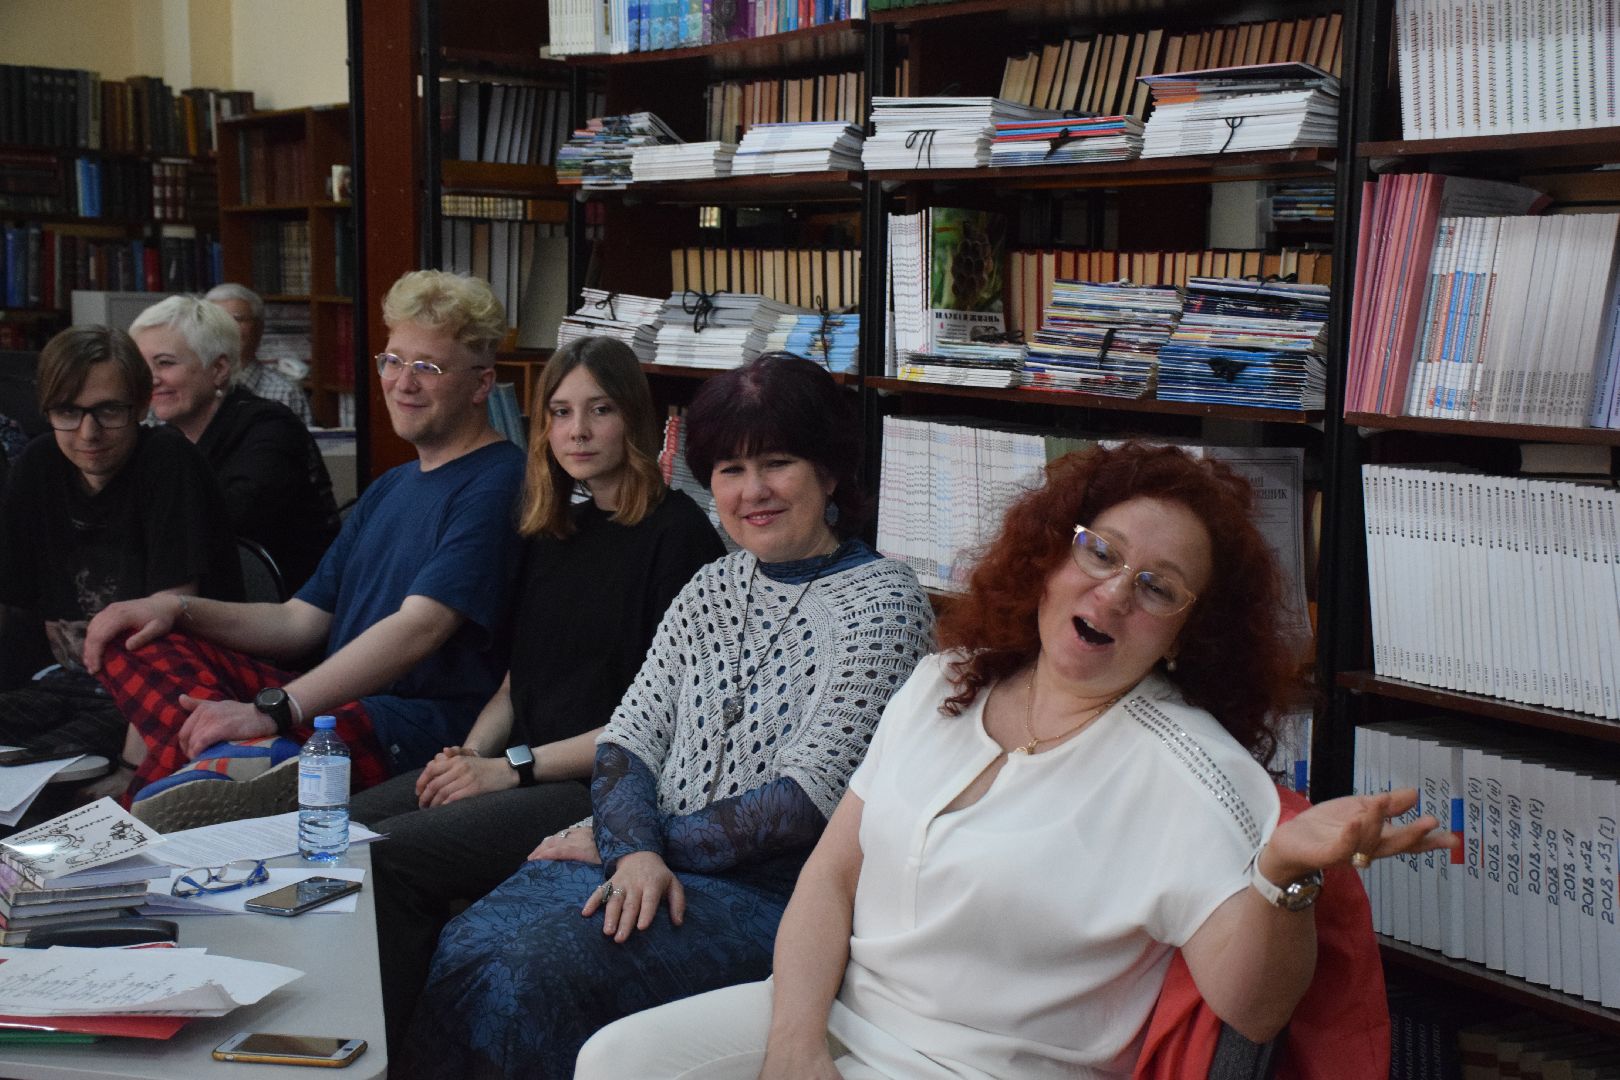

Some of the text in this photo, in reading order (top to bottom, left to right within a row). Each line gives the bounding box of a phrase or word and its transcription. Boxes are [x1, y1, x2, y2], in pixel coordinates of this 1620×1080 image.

[1468, 838, 1479, 880] 2018
[1487, 844, 1500, 882] 2018
[1506, 854, 1520, 896] 2018
[1528, 852, 1541, 896] 2018
[1546, 867, 1558, 906] 2018
[1563, 864, 1576, 902] 2018
[1581, 878, 1594, 916] 2018
[1600, 878, 1614, 925] 2018
